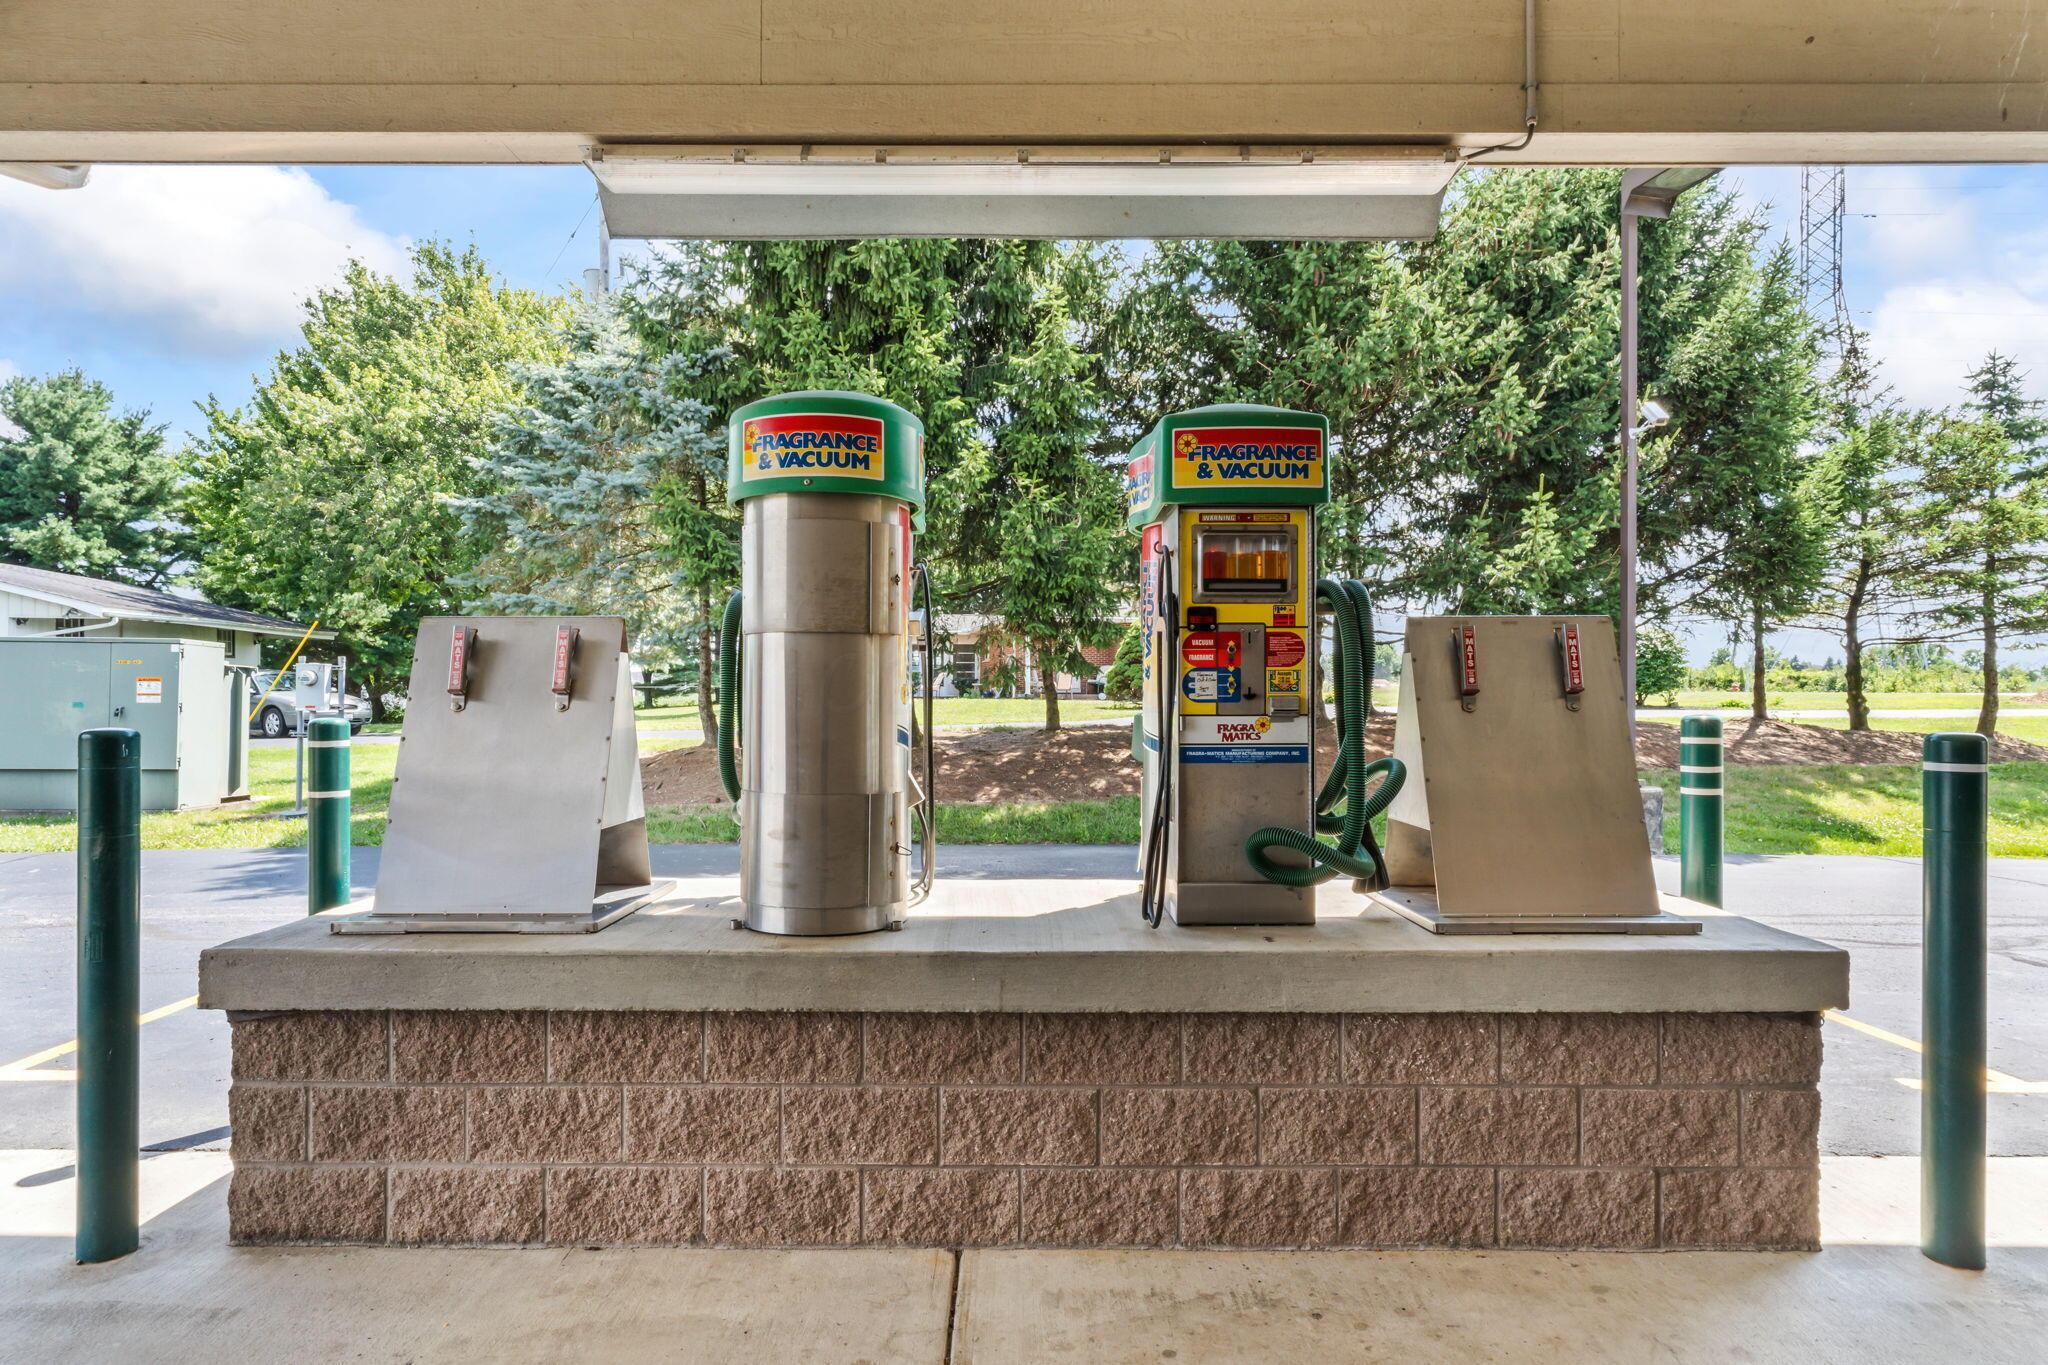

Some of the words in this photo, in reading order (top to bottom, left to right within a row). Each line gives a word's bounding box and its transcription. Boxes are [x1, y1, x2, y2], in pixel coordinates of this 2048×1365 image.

[752, 432, 877, 452] FRAGRANCE
[758, 452, 773, 470] &
[777, 451, 870, 470] VACUUM
[1188, 445, 1317, 461] FRAGRANCE
[1196, 462, 1214, 479] &
[1217, 463, 1310, 479] VACUUM
[454, 640, 463, 668] MATS
[1466, 638, 1474, 667] MATS
[1568, 639, 1578, 668] MATS
[1217, 723, 1256, 734] FRAGRA
[1221, 732, 1262, 742] MATICS
